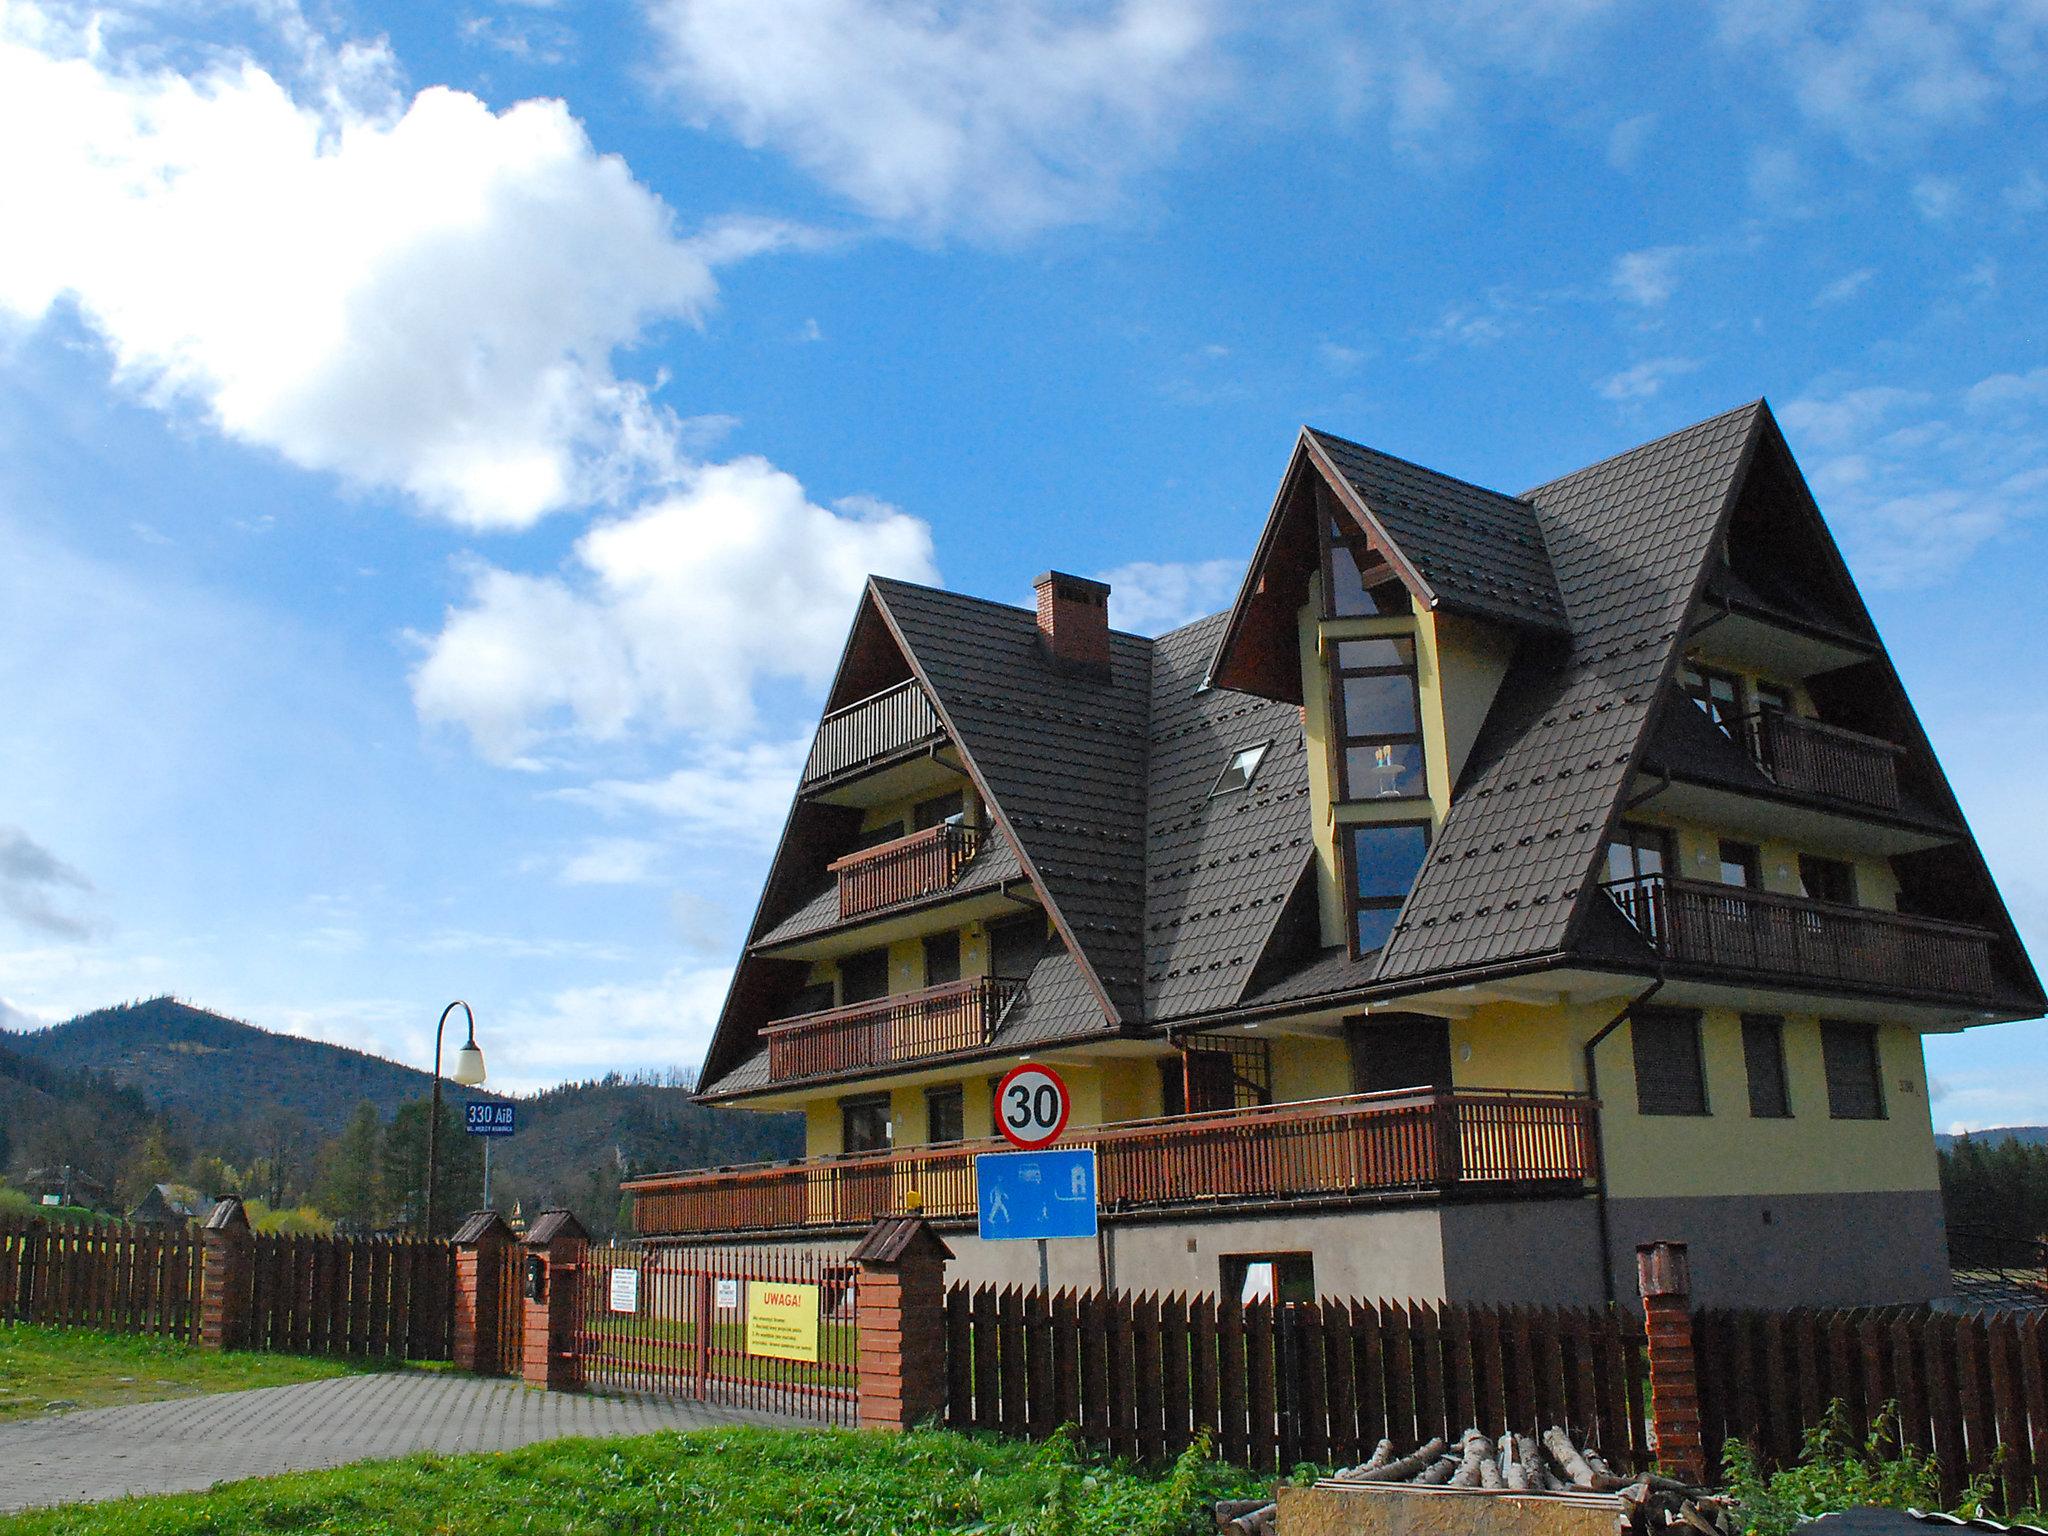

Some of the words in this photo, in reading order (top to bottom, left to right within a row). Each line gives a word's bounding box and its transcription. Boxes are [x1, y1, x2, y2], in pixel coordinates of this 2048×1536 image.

[469, 1105, 492, 1123] 330
[495, 1107, 512, 1123] AiB
[1007, 1084, 1059, 1129] 30
[764, 1292, 802, 1307] UWAGA!
